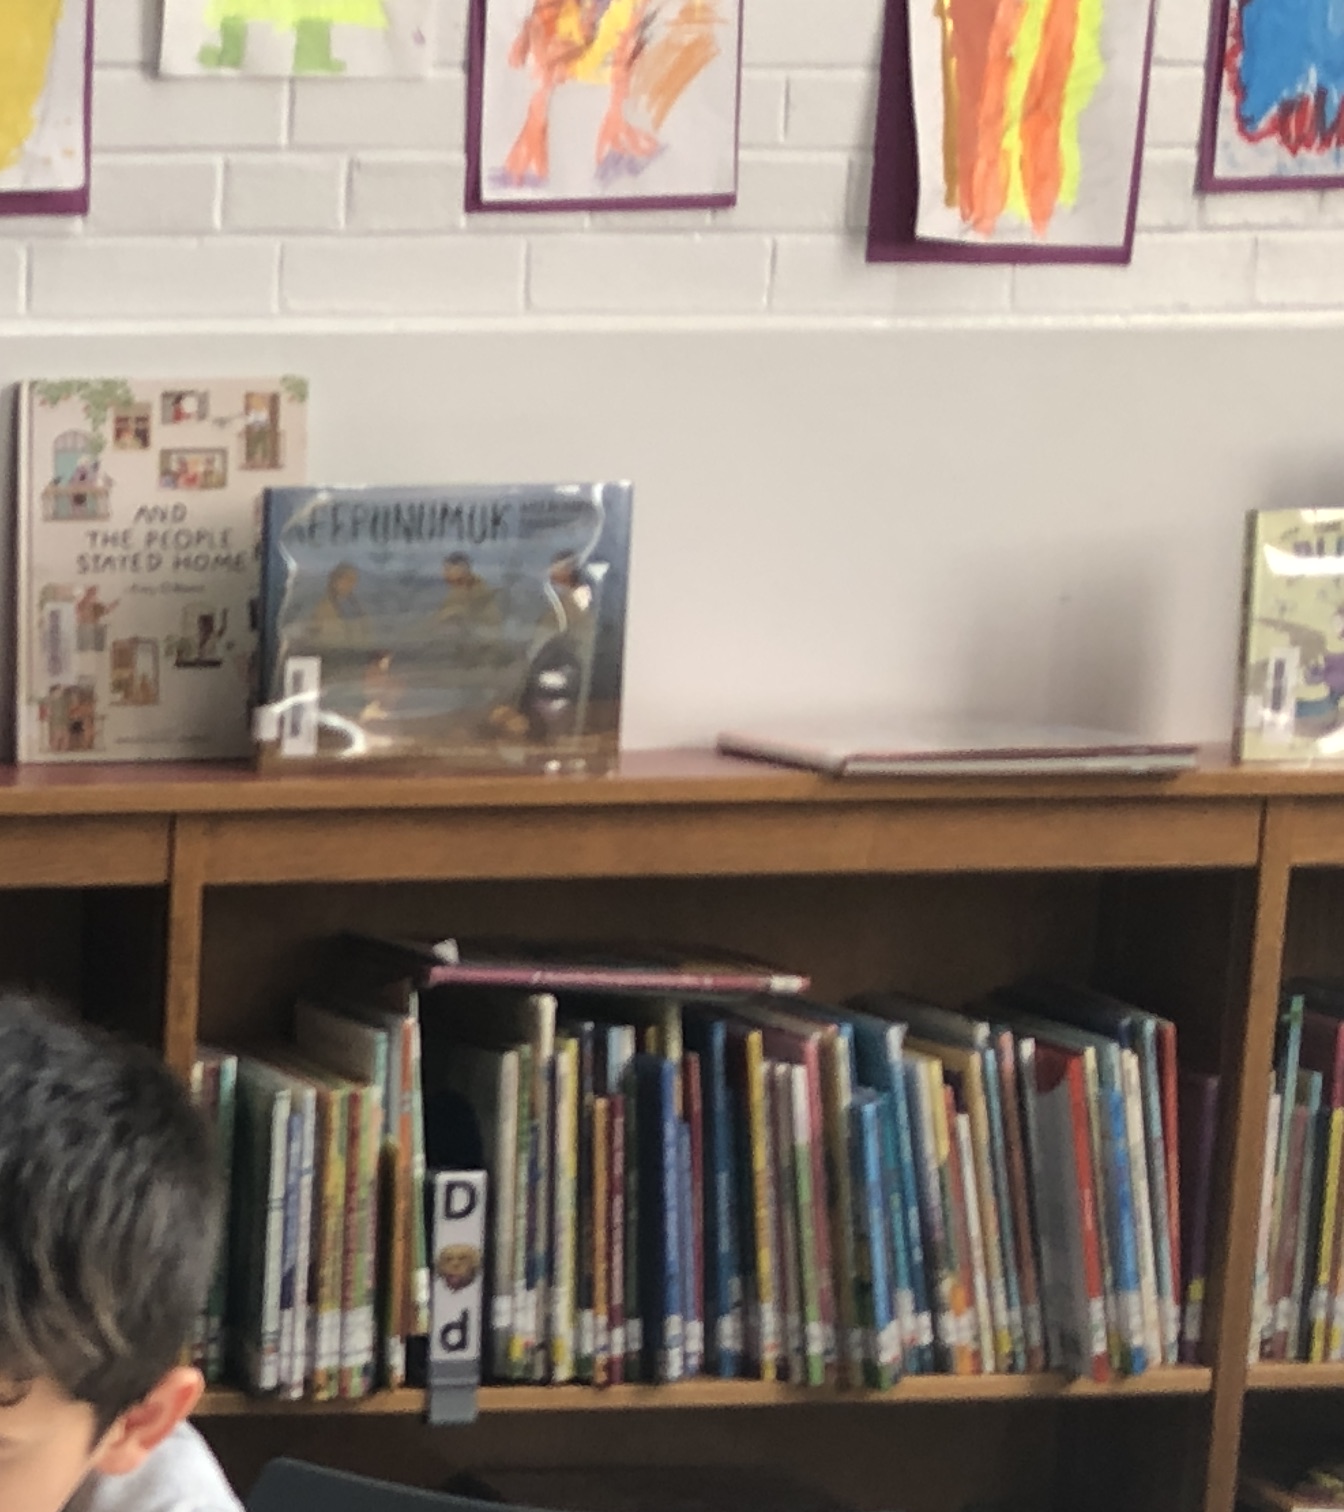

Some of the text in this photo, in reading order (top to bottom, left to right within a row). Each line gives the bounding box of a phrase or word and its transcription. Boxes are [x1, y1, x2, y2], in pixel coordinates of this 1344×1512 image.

[134, 502, 188, 524] AND
[85, 527, 232, 550] THE PEOPLE
[172, 551, 248, 573] HOME
[444, 1181, 477, 1219] D
[440, 1309, 469, 1352] d
